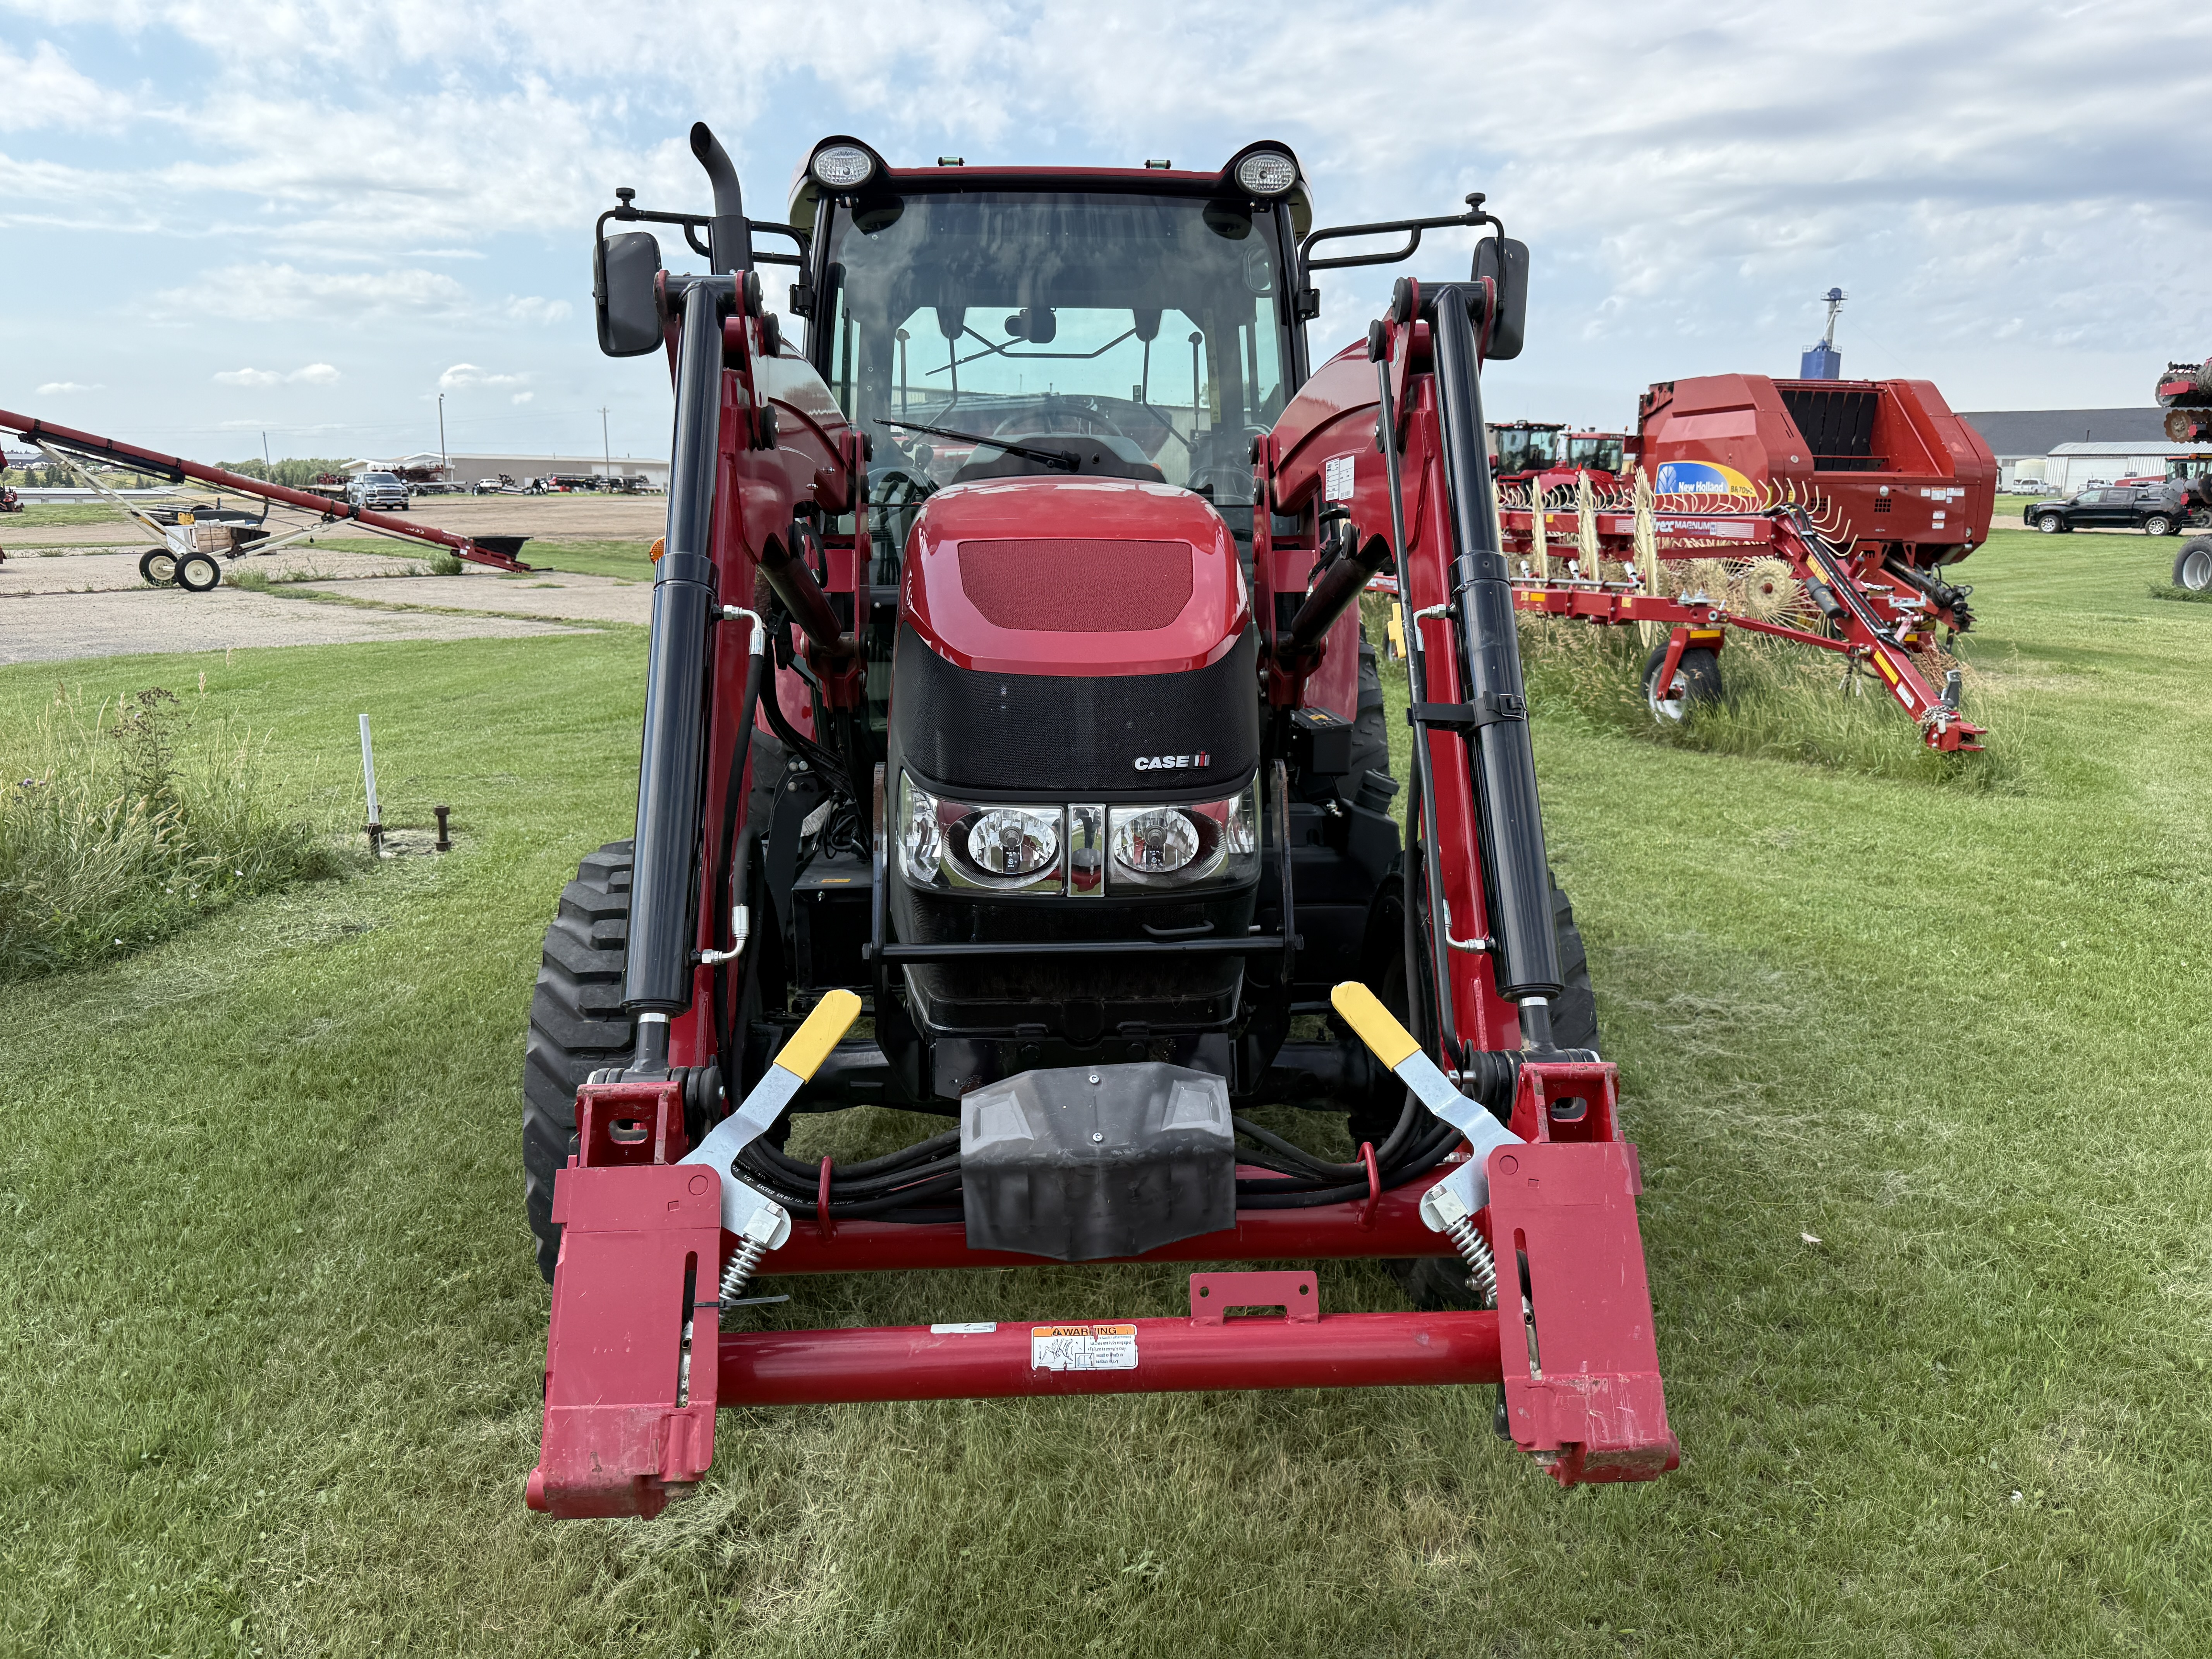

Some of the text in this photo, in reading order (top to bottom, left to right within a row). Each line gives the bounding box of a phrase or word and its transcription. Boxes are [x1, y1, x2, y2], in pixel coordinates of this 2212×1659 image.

[1678, 481, 1724, 493] New Holland
[1674, 520, 1710, 530] MAGNUM
[1134, 751, 1210, 770] CASE IH
[757, 1183, 775, 1194] EXCEED
